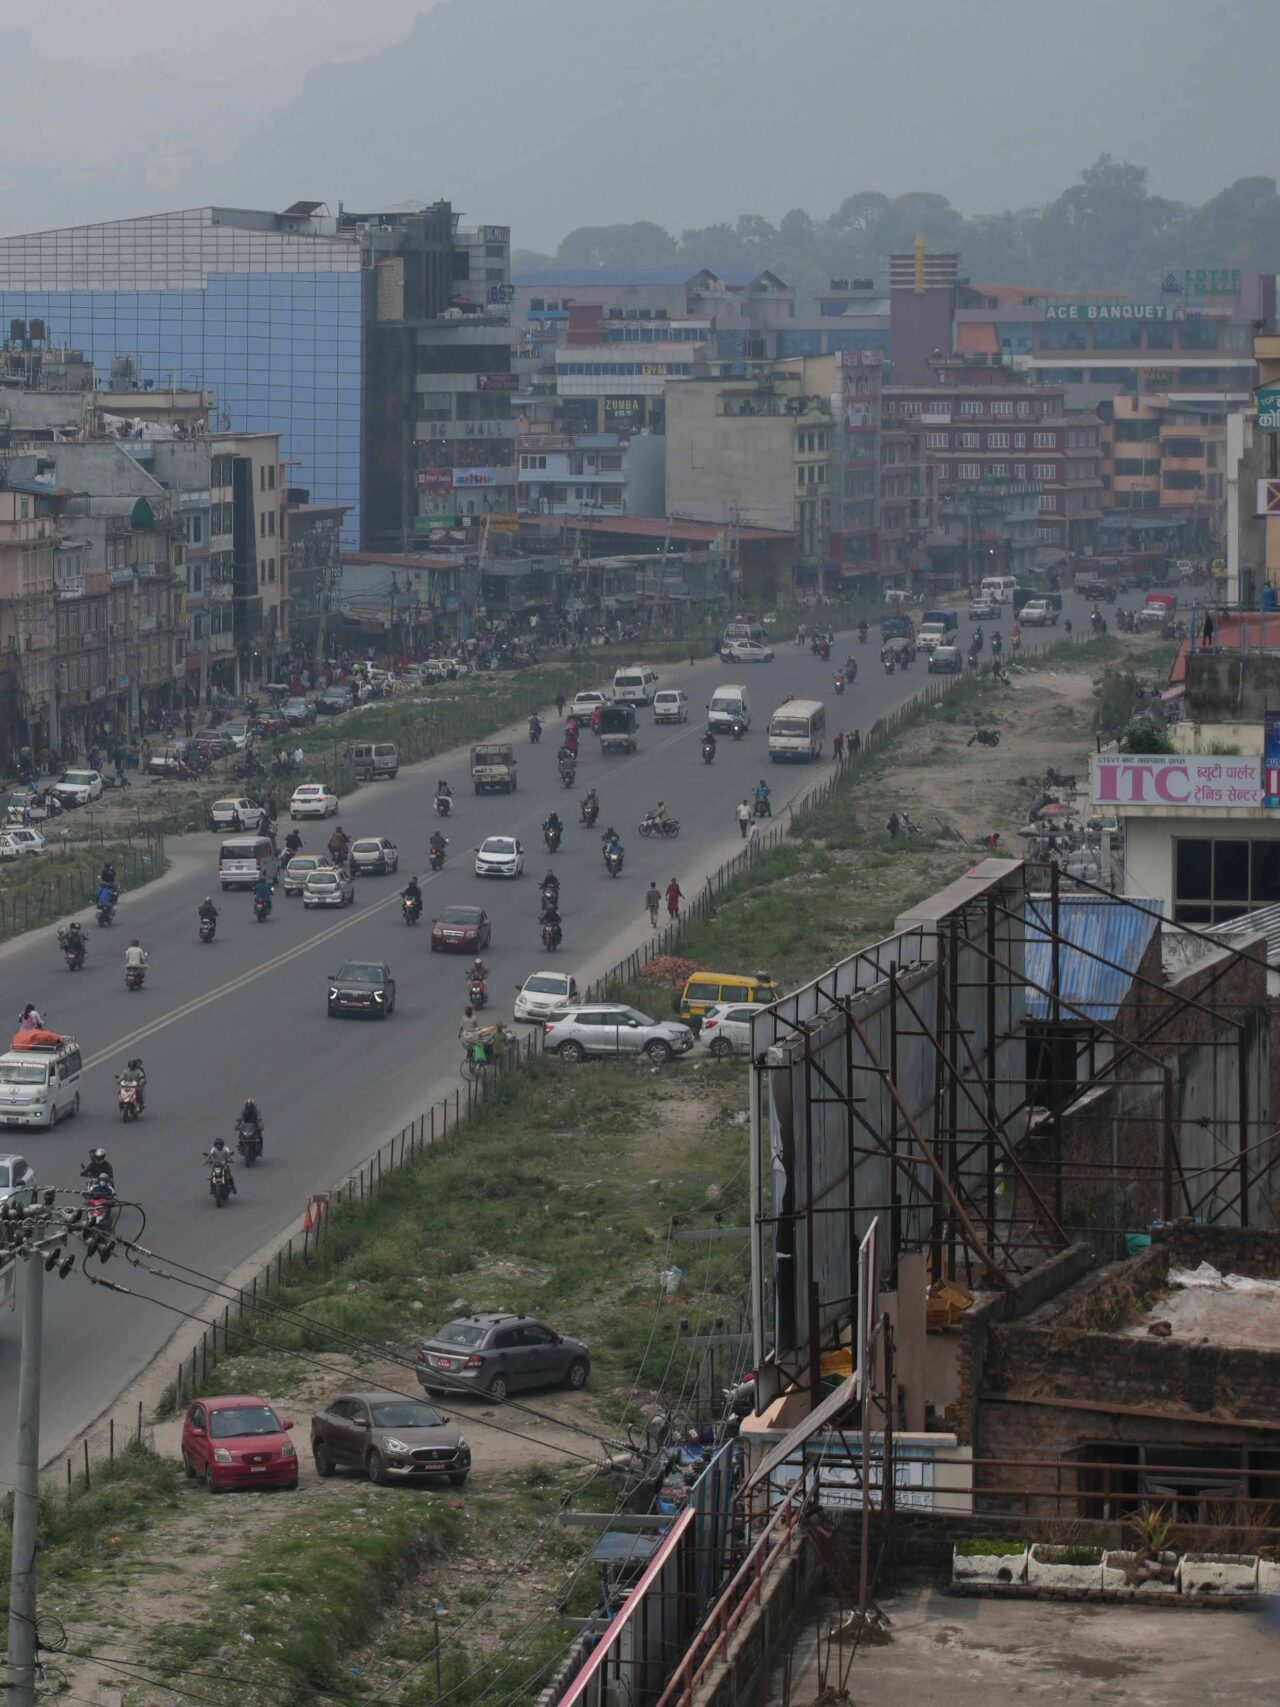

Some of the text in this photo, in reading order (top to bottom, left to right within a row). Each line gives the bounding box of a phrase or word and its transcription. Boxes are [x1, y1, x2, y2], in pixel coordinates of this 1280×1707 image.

[1046, 305, 1164, 319] ACE BANQUET
[642, 363, 667, 375] GYM
[606, 400, 638, 410] ZUMBA
[1197, 764, 1221, 782] ब्युटी
[1097, 765, 1191, 803] ITC
[1227, 786, 1259, 802] सेन्टर
